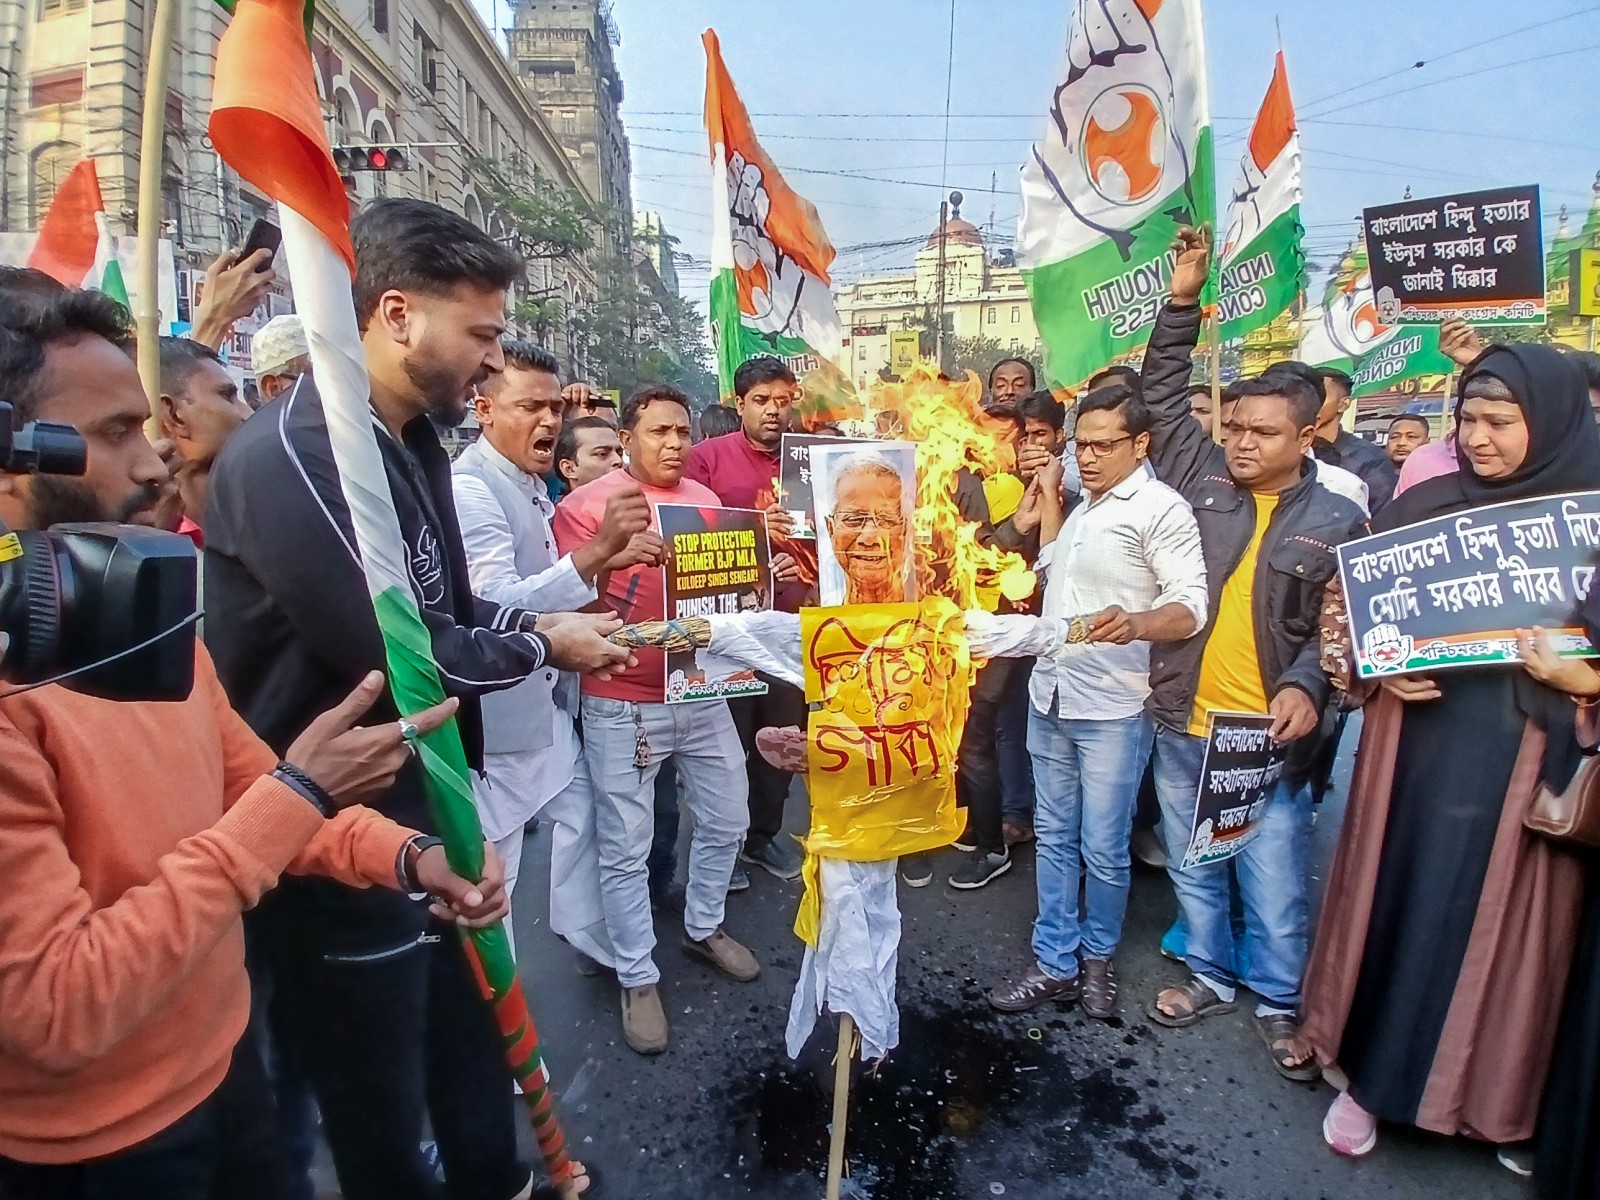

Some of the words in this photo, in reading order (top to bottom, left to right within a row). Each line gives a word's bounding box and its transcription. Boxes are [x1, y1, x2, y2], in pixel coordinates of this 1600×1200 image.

[1370, 209, 1438, 237] বাংলাদেশে
[1443, 202, 1477, 234] হিন্দু
[1482, 199, 1531, 225] হত্যার
[1383, 241, 1426, 267] ইউনুস
[1433, 236, 1486, 261] সরকার
[1493, 234, 1518, 254] কে
[1402, 266, 1445, 292] জানাই
[1451, 264, 1498, 290] ধিক্কার
[1503, 302, 1535, 319] কমিটি
[674, 533, 699, 553] STOP
[700, 530, 756, 552] PROTECTING
[1349, 532, 1451, 584] বাংলাদেশে
[1455, 517, 1510, 571] হিন্দু
[1508, 513, 1559, 555] হত্যা
[676, 551, 715, 573] FORMER
[716, 550, 735, 569] BJP
[736, 548, 757, 567] MLA
[676, 574, 706, 591] KULDEEP
[708, 572, 728, 587] SINGH
[729, 568, 759, 585] SENGAR!
[1368, 576, 1421, 624] মোদি
[1427, 571, 1504, 613] সরকার
[1506, 554, 1566, 606] নীরব
[676, 596, 715, 619] PUNISH
[718, 592, 738, 614] THE
[1216, 726, 1268, 752] বাংলাদেশে
